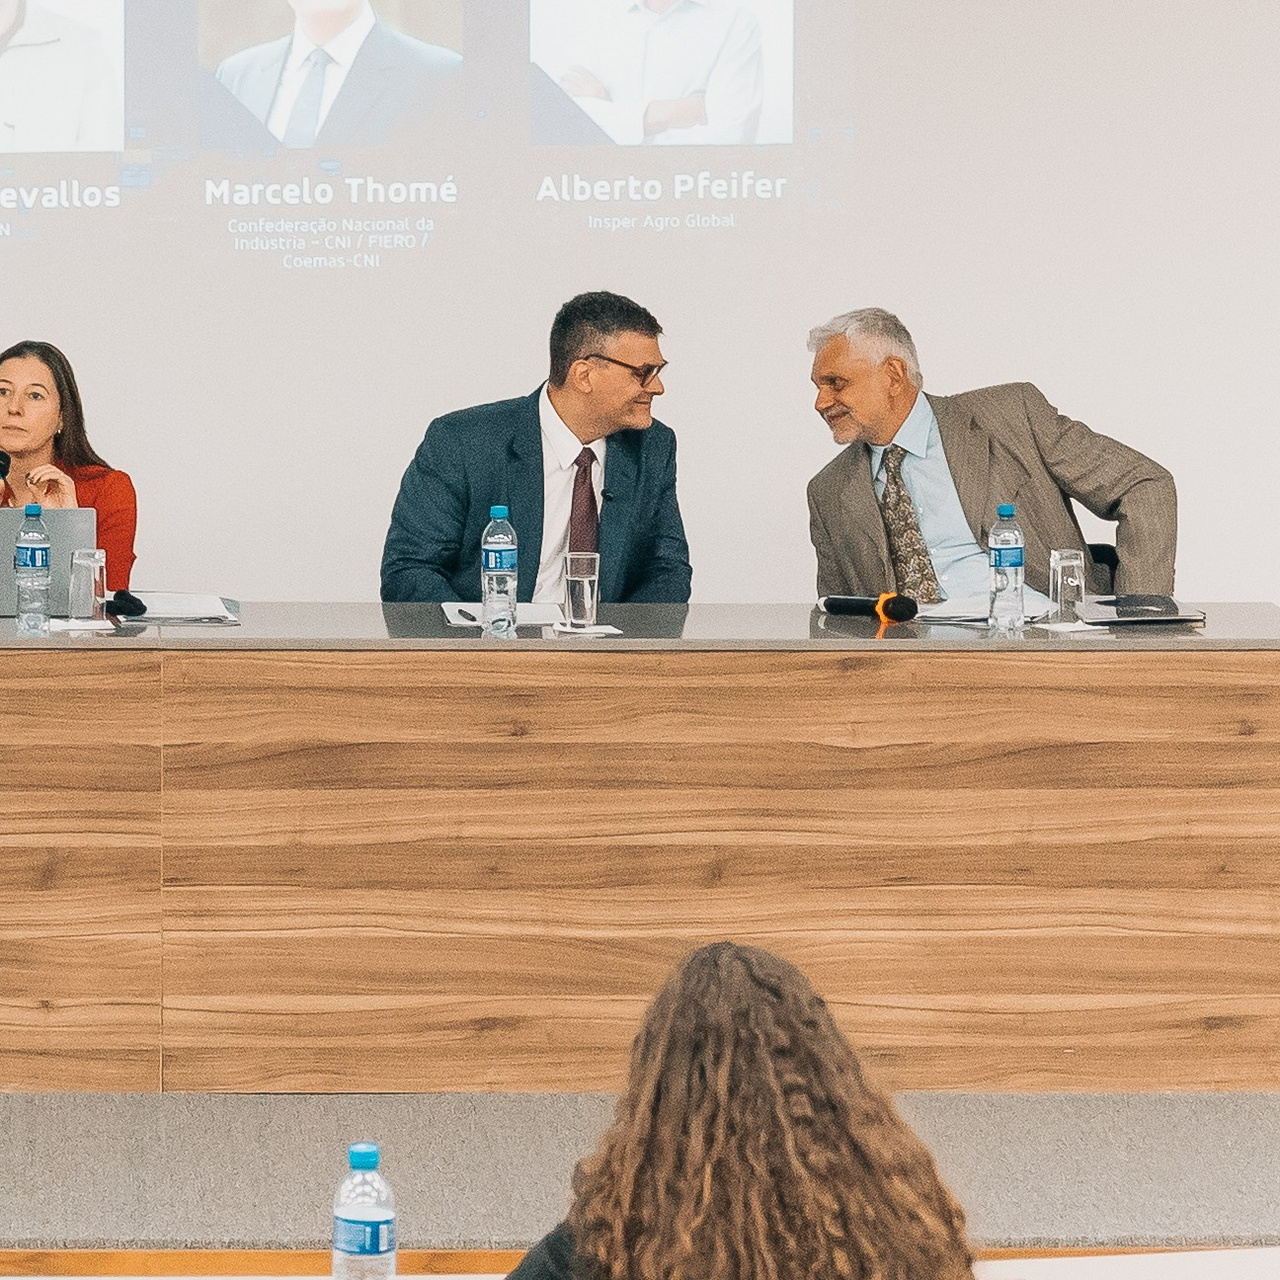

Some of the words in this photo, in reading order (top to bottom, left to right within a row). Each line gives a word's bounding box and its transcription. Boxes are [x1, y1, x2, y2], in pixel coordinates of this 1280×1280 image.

[204, 176, 334, 205] Marcelo
[344, 175, 458, 203] Thomé
[536, 174, 662, 202] Alberto
[674, 171, 788, 199] Pfeifer
[228, 220, 337, 235] Confederação
[342, 217, 409, 232] Nacional
[416, 217, 434, 230] da
[588, 215, 636, 230] Insper
[643, 214, 680, 232] Agro
[686, 214, 736, 228] Global
[324, 235, 352, 248] CNI
[283, 254, 380, 268] Coemas-CNI
